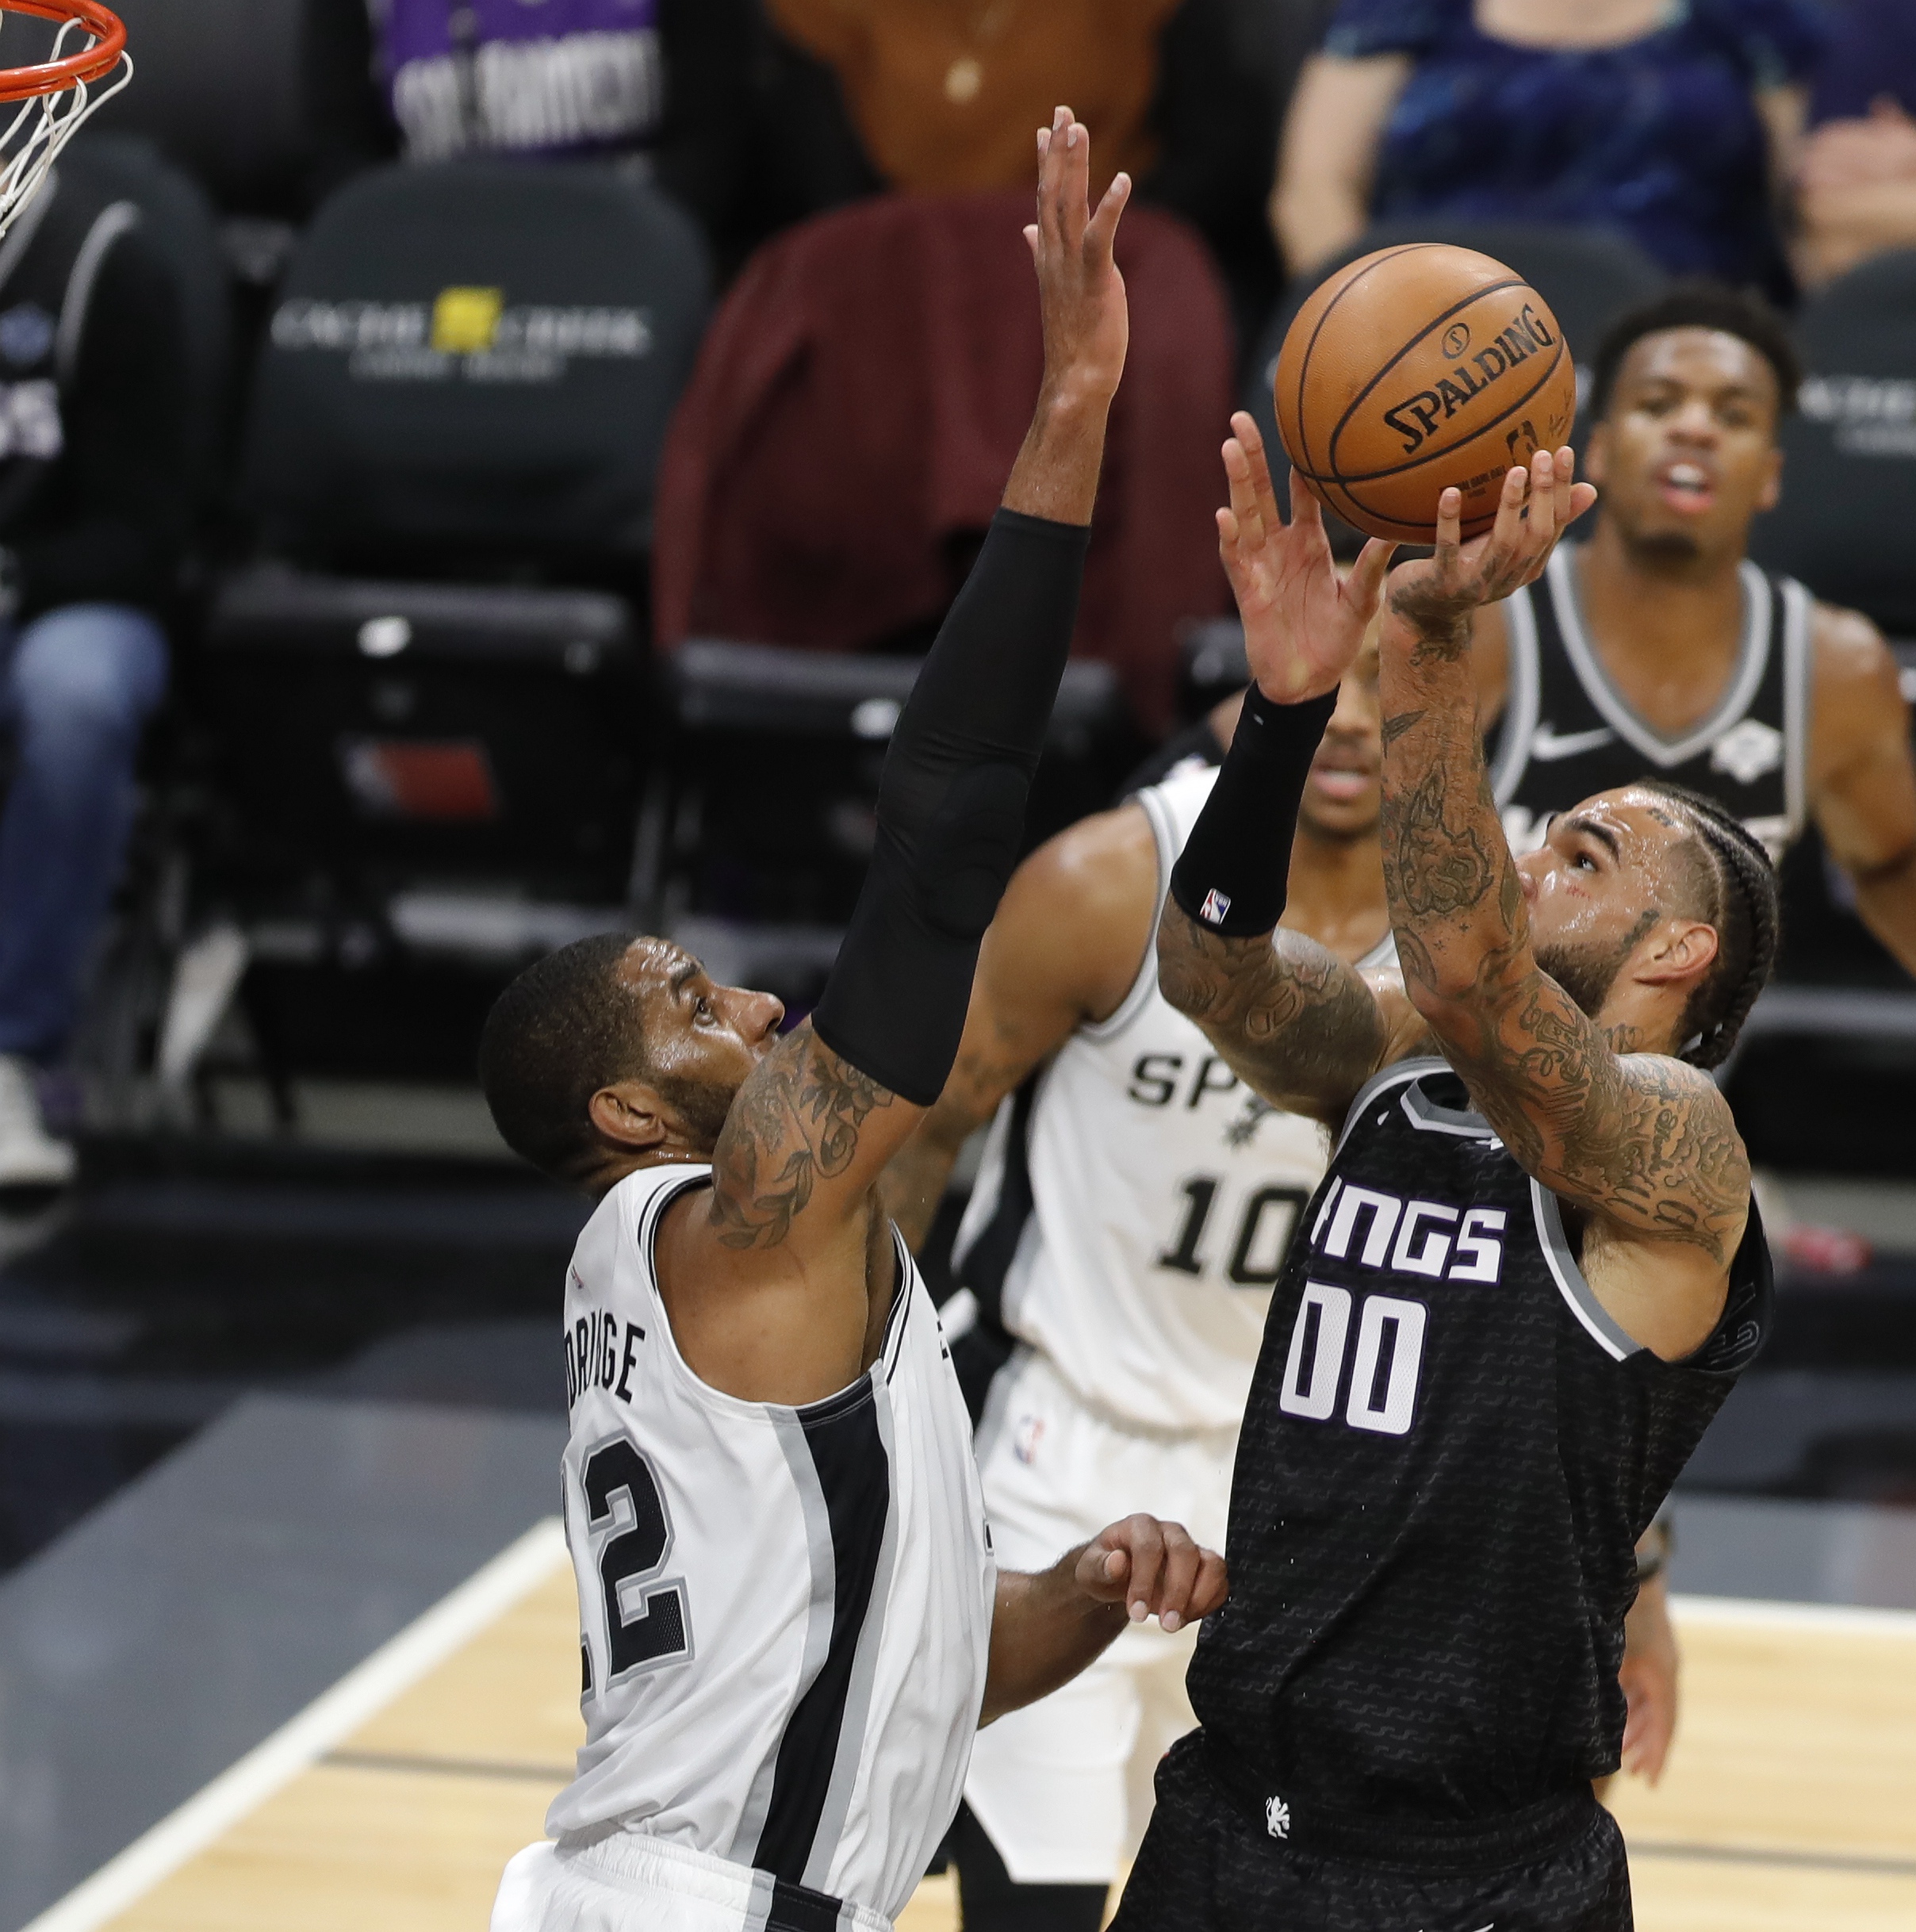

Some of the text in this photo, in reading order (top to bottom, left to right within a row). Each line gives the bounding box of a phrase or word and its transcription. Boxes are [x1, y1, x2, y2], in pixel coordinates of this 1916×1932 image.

[1384, 303, 1556, 454] SPALDING
[1125, 1052, 1239, 1109] SP
[1158, 1177, 1309, 1284] 10
[1279, 1279, 1427, 1436] 00
[561, 1430, 695, 1701] 2
